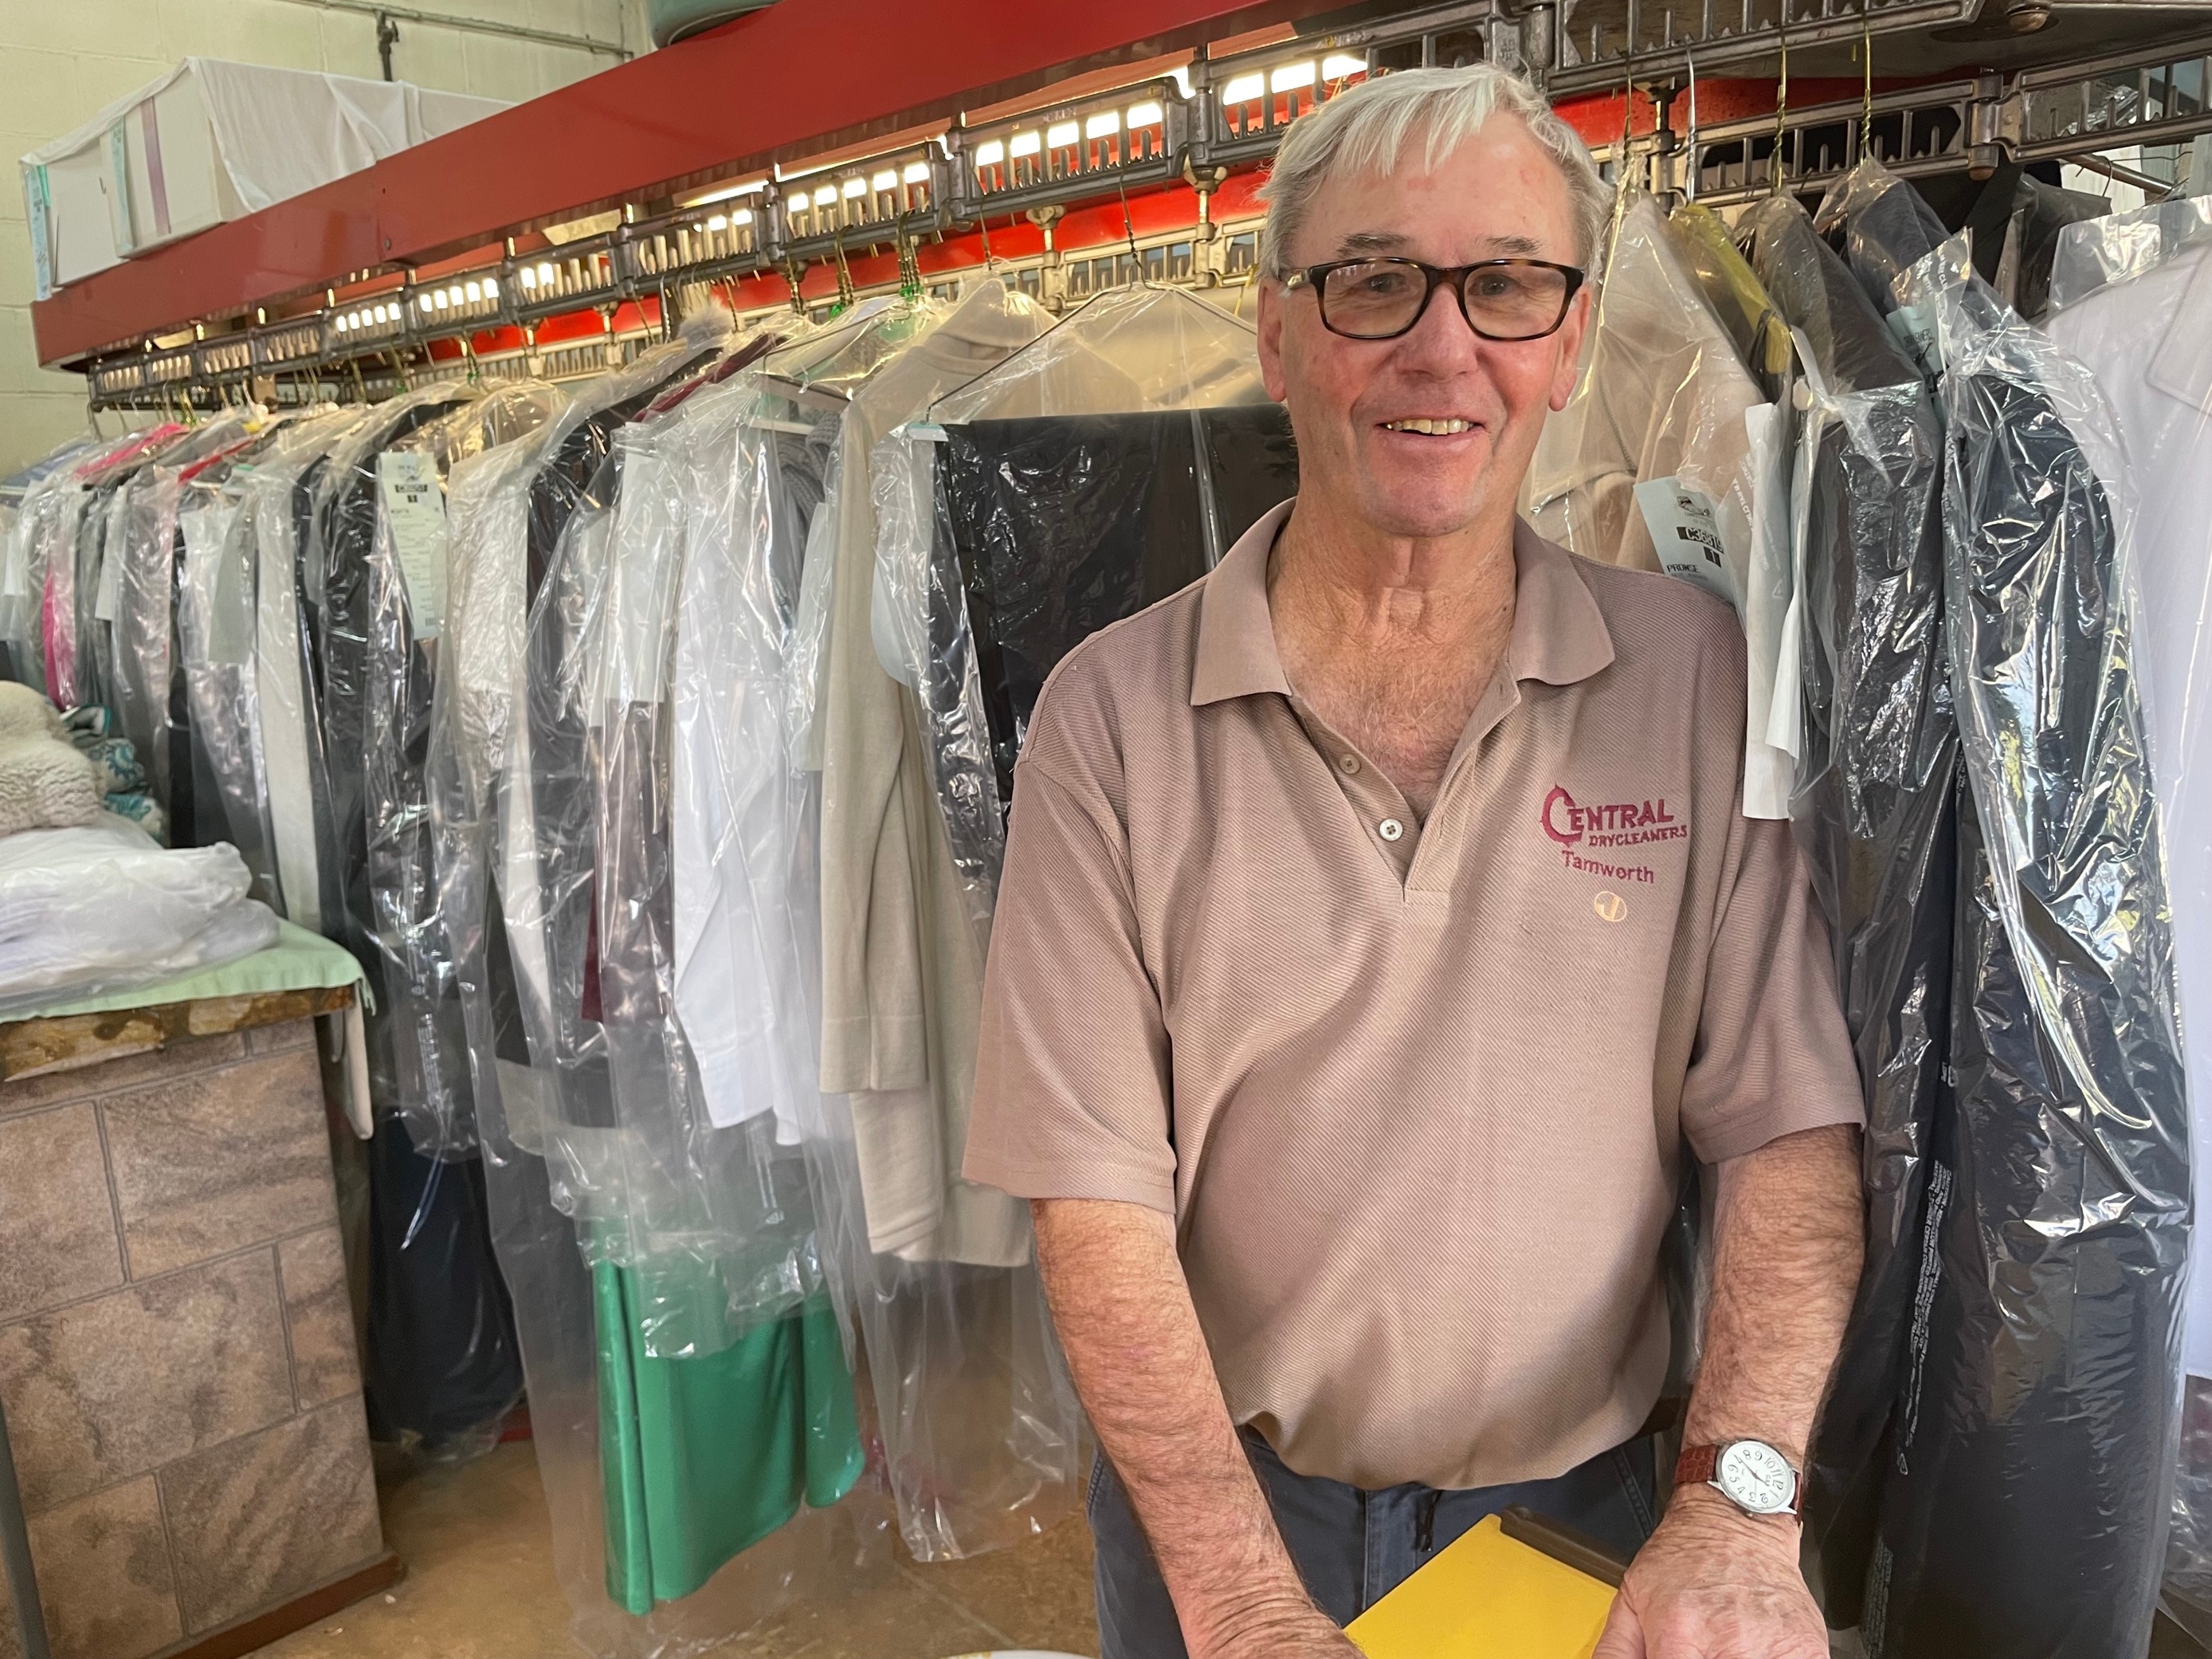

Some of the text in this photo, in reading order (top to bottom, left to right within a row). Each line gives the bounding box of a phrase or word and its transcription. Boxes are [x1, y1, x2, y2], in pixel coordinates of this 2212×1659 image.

[1539, 784, 1675, 848] CENTRAL
[1588, 824, 1688, 847] DRYCLEANERS
[1562, 849, 1654, 884] Tamworth
